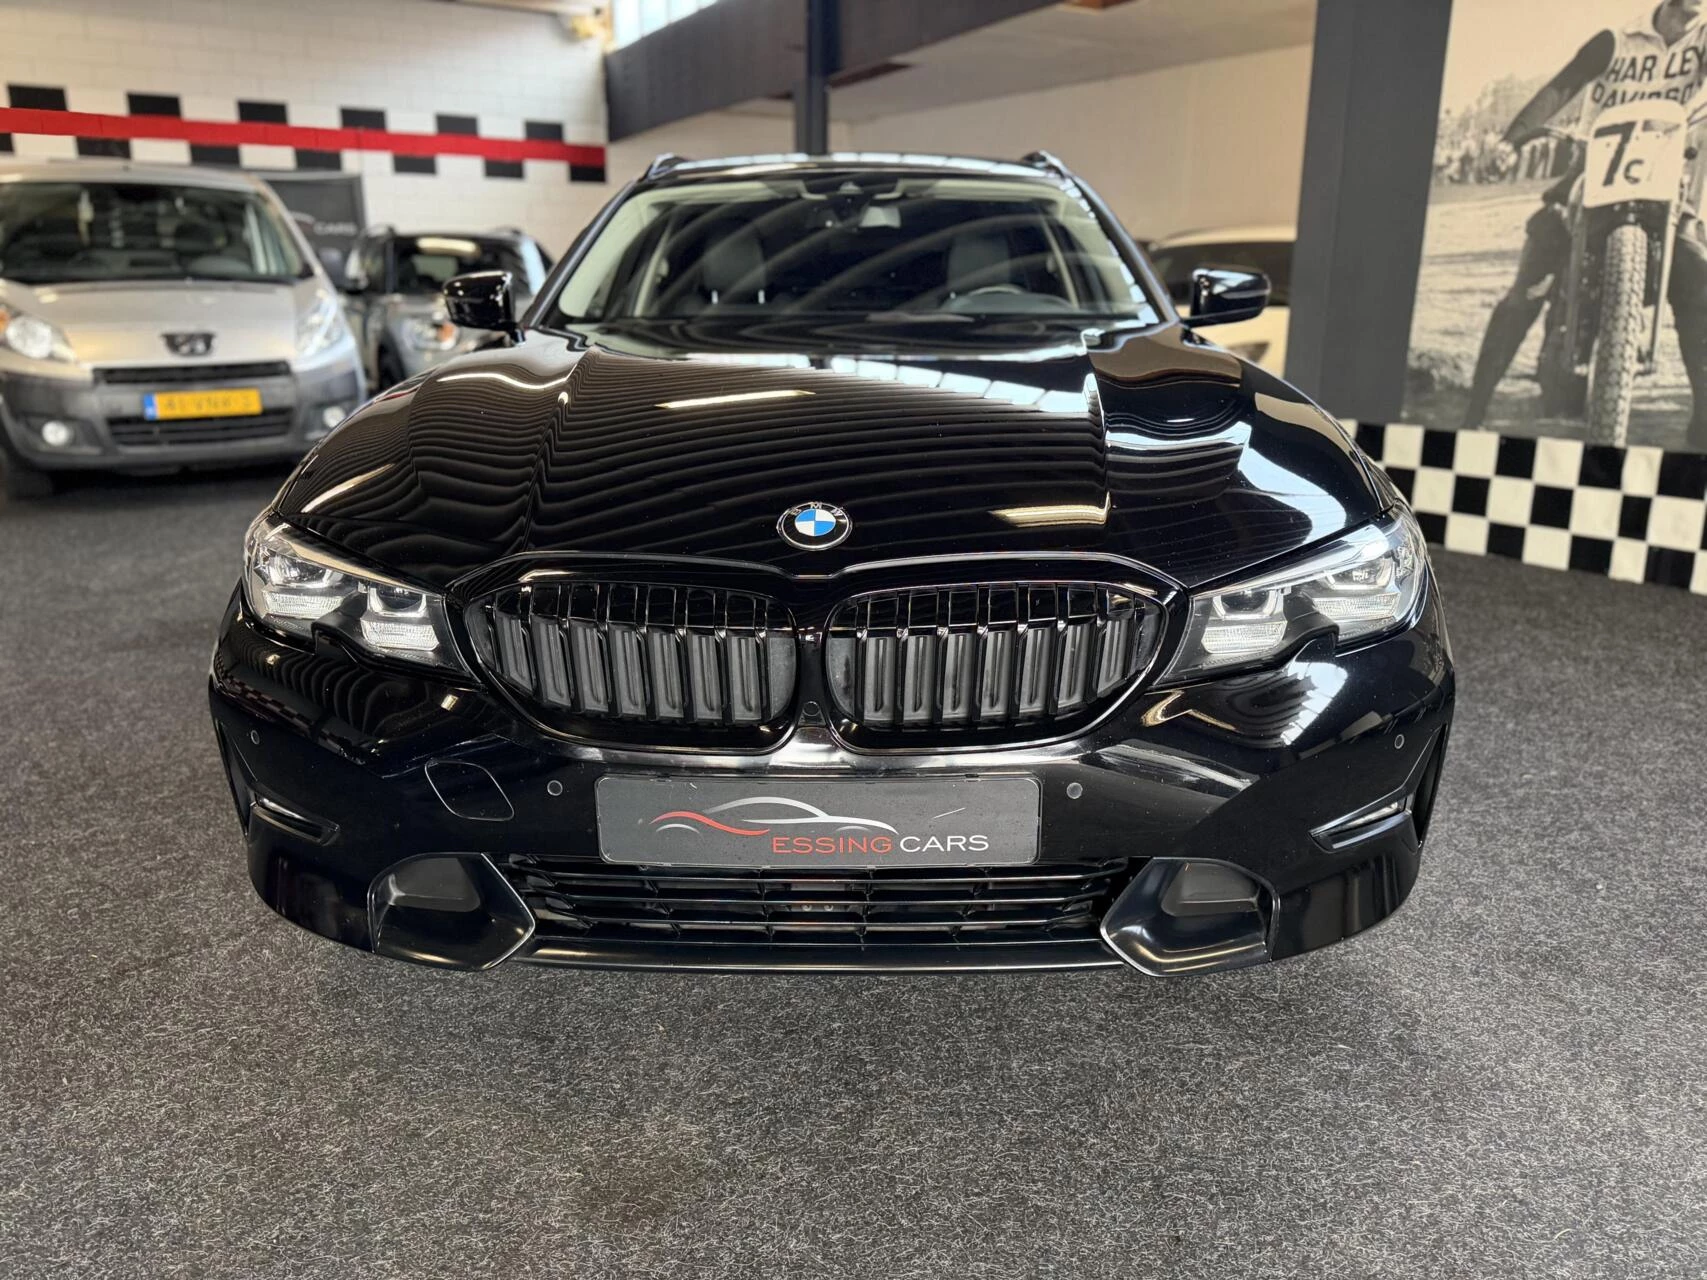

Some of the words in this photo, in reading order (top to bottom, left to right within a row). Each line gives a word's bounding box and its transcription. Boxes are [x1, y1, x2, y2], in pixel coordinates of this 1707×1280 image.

[788, 501, 845, 517] BMW
[771, 836, 892, 855] ESSING
[899, 834, 990, 853] CARS
